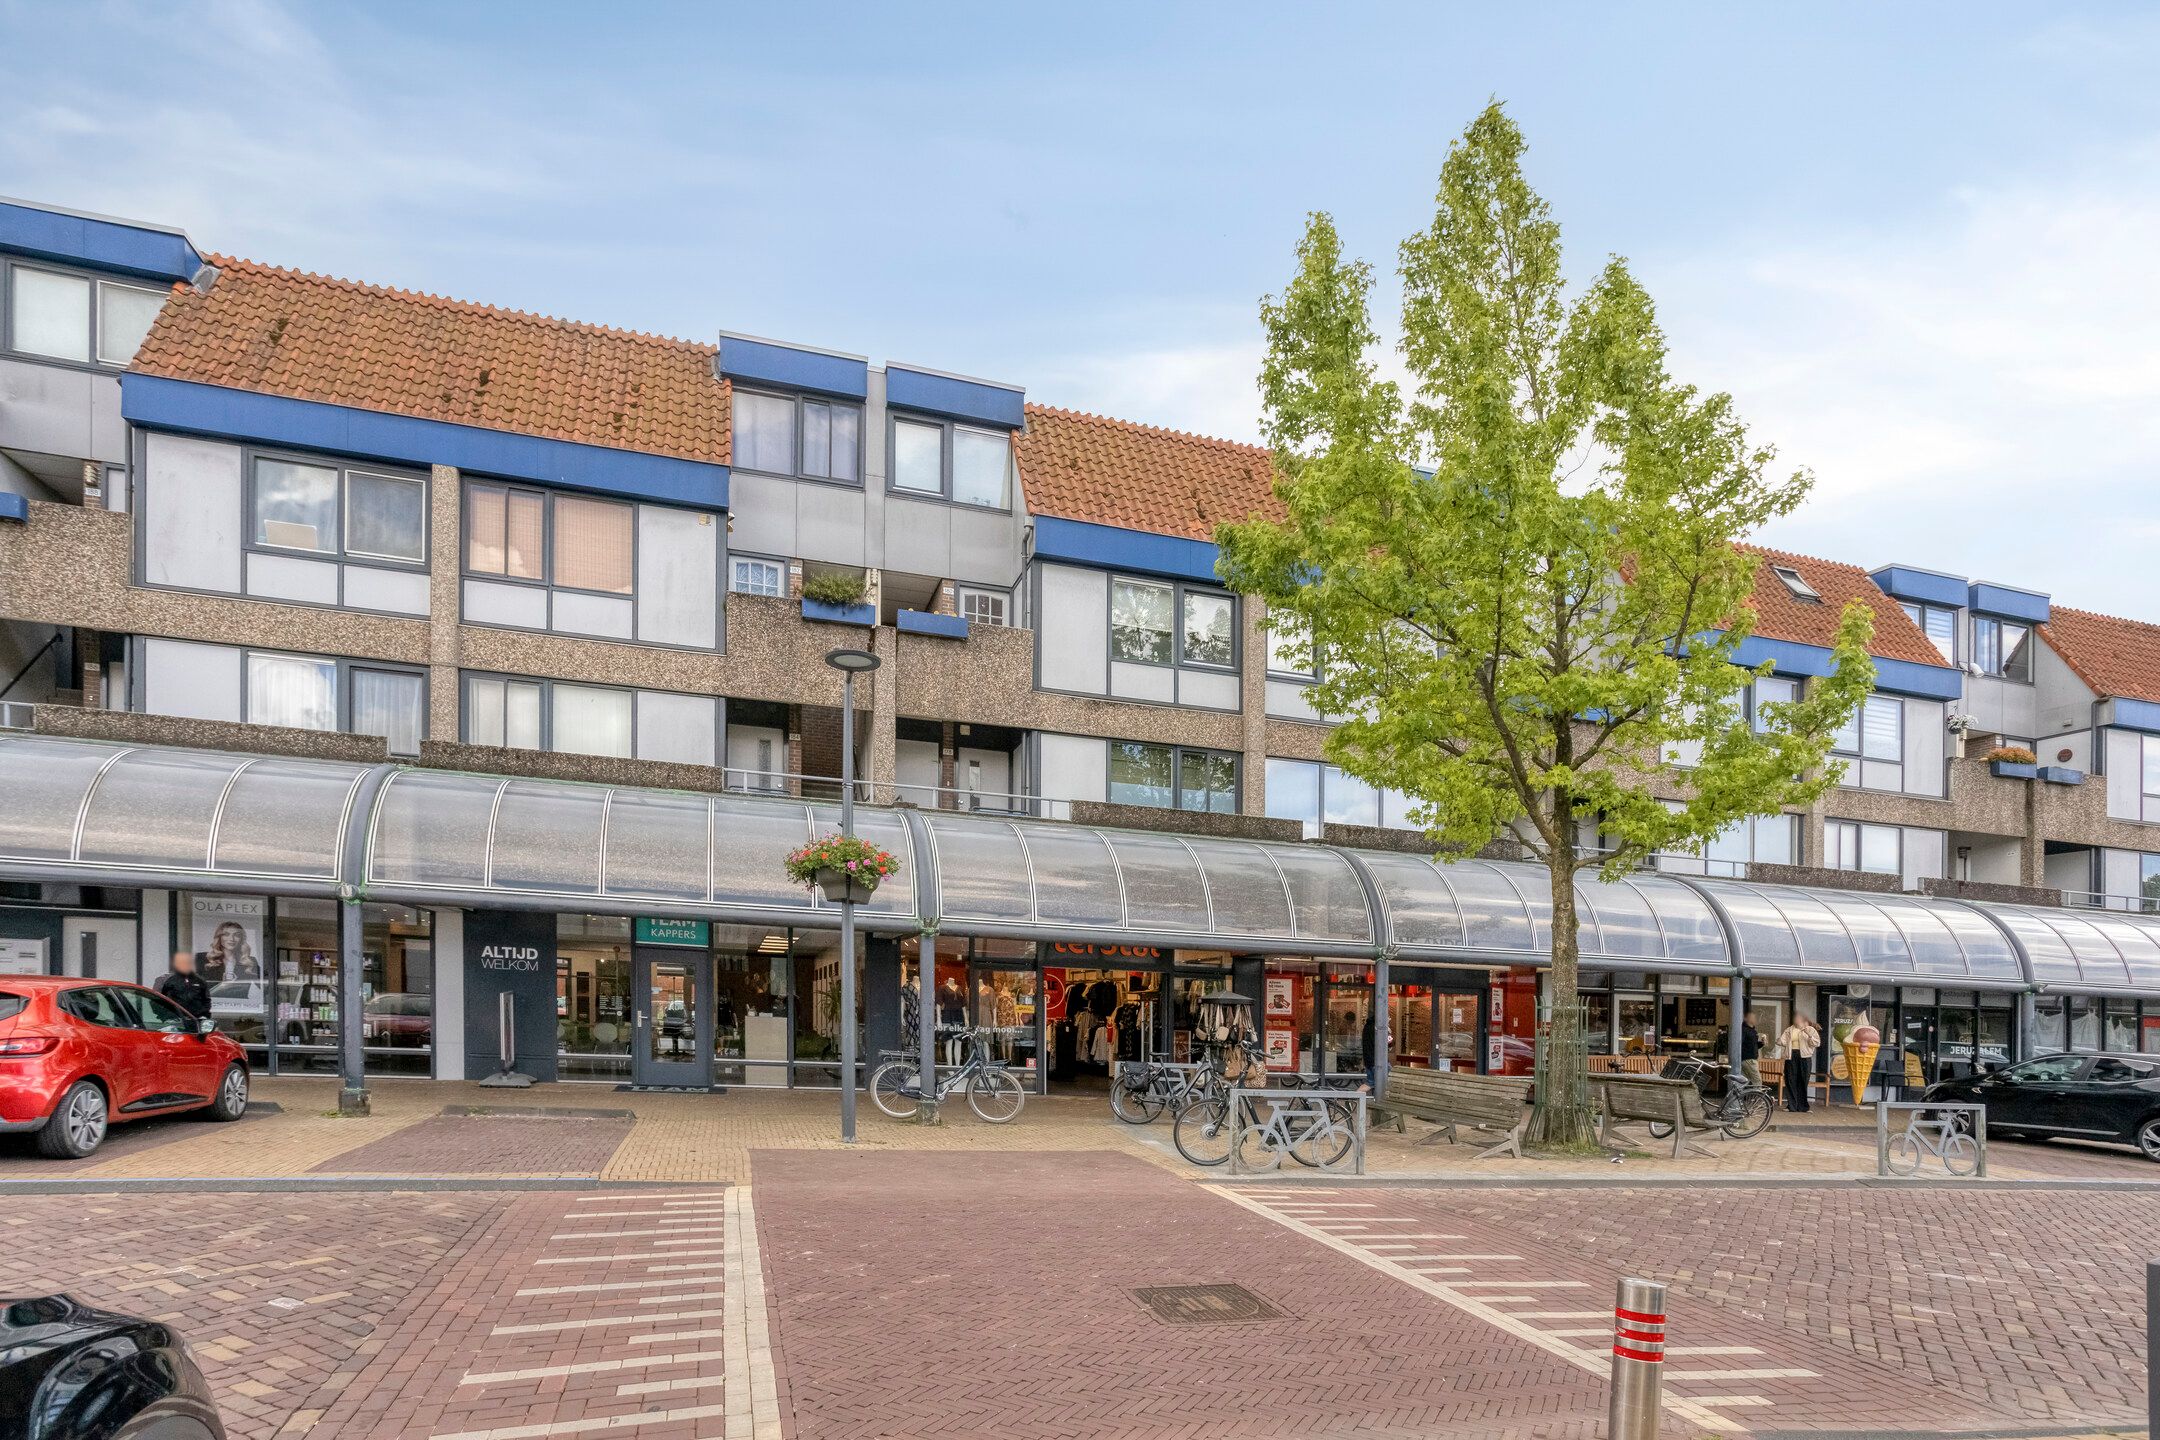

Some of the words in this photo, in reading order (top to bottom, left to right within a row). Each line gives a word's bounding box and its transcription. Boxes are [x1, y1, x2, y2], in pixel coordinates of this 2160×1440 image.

[194, 901, 258, 914] OLAPLEX
[651, 928, 696, 939] KAPPERS
[481, 945, 538, 960] ALTIJD
[481, 958, 538, 971] WELKOM
[632, 1085, 709, 1093] TEAM
